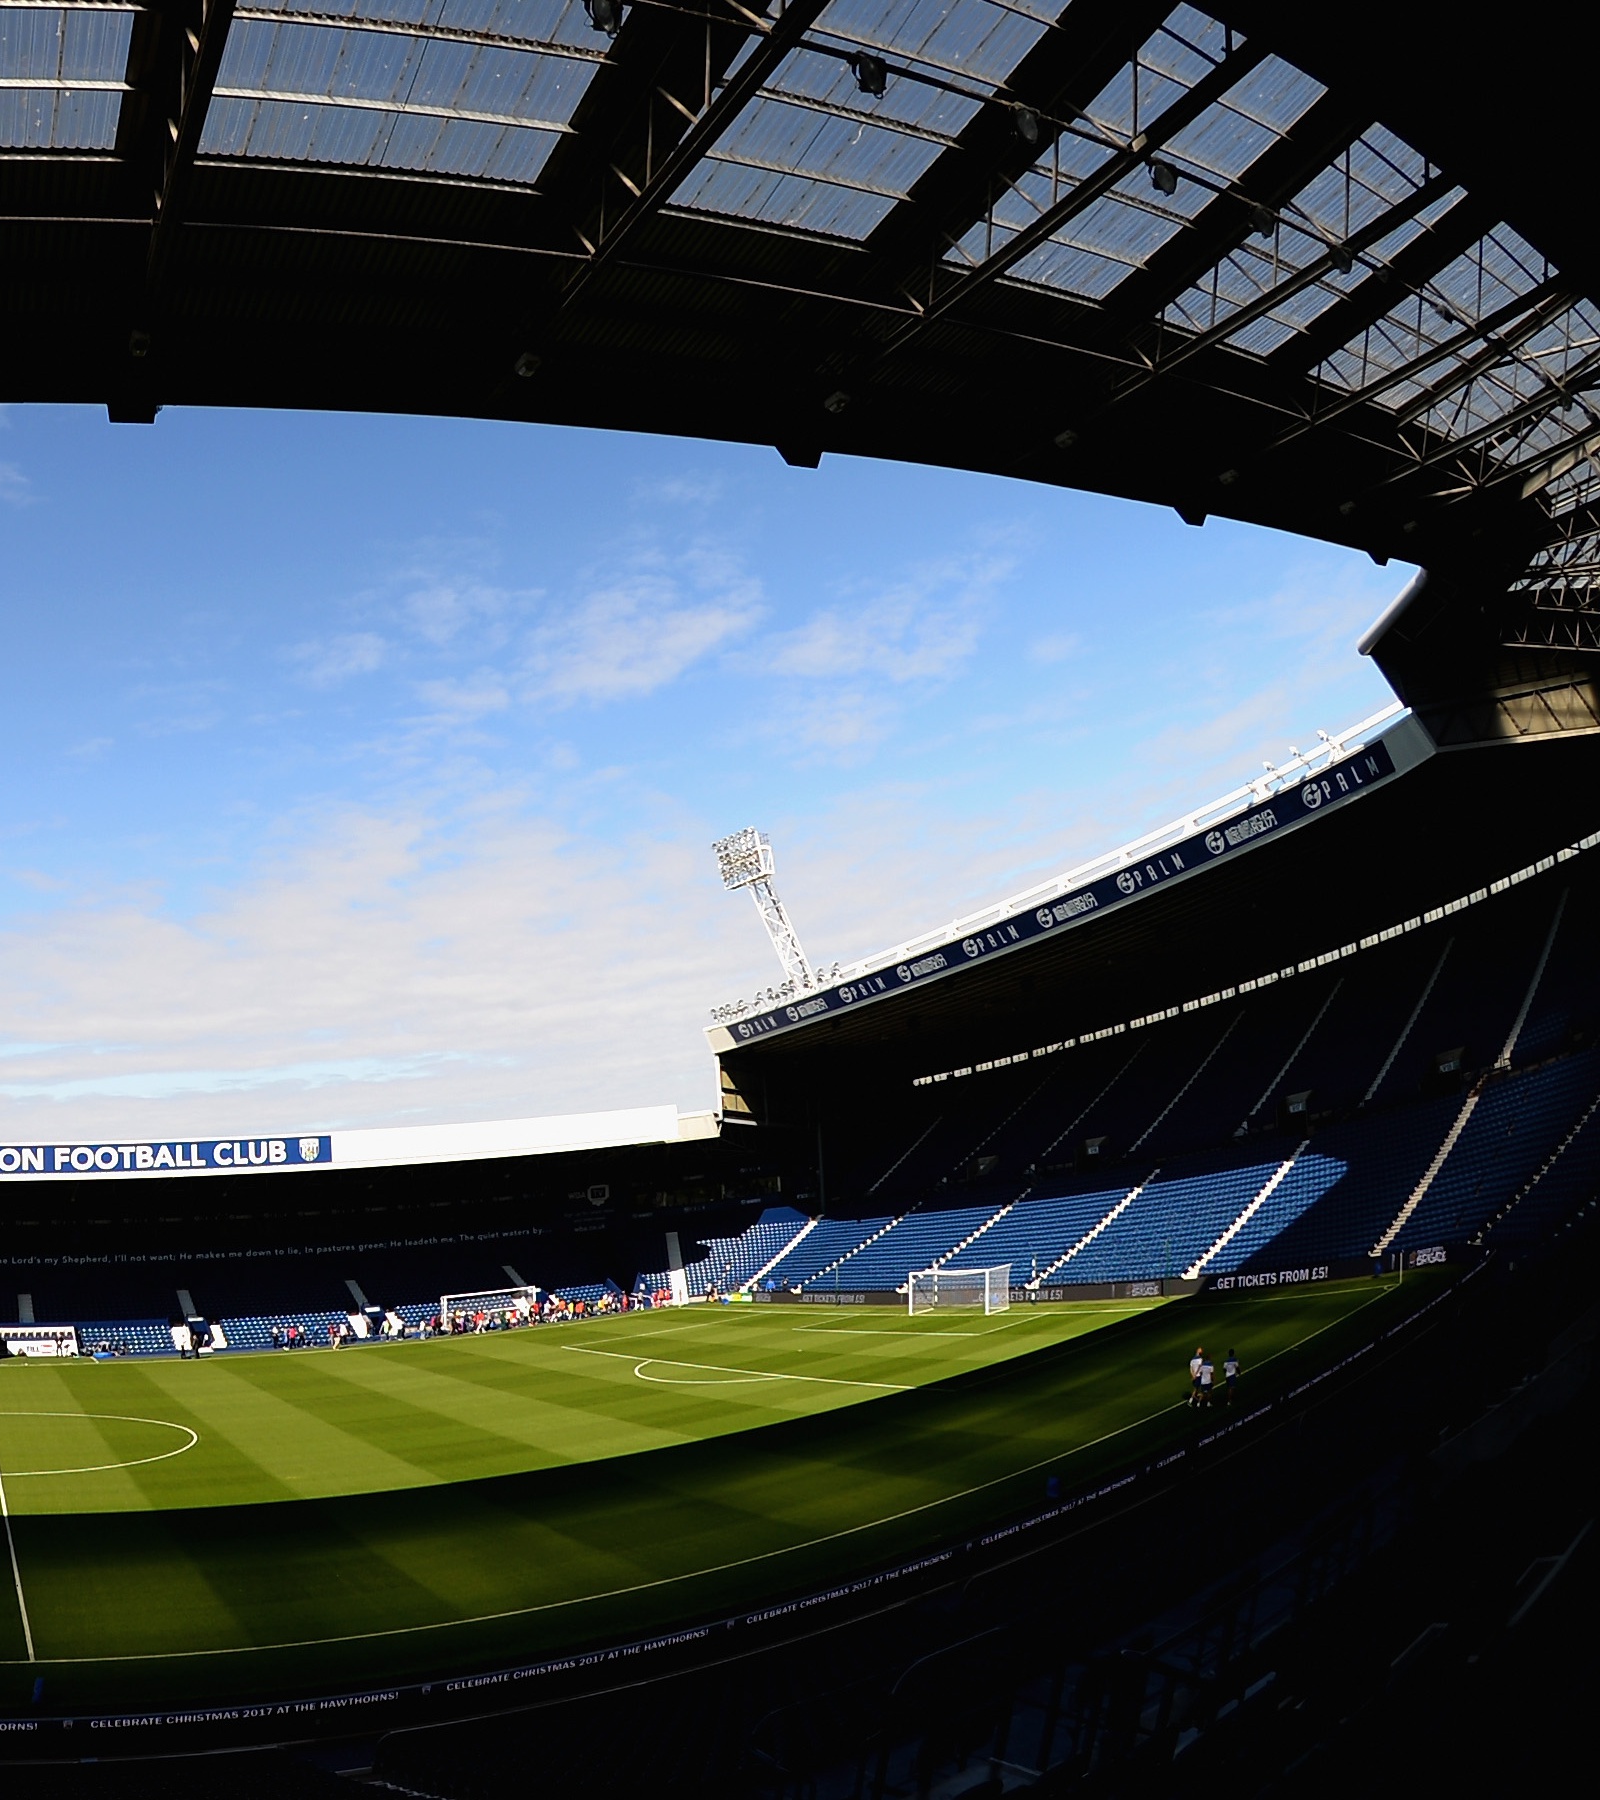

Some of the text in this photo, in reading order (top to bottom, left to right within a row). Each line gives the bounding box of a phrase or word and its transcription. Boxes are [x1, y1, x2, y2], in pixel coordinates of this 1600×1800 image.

[1320, 756, 1380, 800] PALM
[1132, 852, 1185, 887] PALM
[54, 1143, 207, 1171] FOOTBALL
[213, 1141, 287, 1166] CLUB
[11, 1256, 41, 1264] Lord's
[179, 1252, 192, 1260] He
[195, 1251, 225, 1259] makes
[245, 1249, 271, 1257] down
[274, 1248, 284, 1256] to
[405, 1237, 438, 1246] leadeth
[1237, 1272, 1277, 1288] TICKETS
[1279, 1268, 1309, 1284] FROM
[1311, 1265, 1329, 1280] £5!
[1025, 1290, 1049, 1301] FOM
[746, 1603, 798, 1625] CELEBRATE
[799, 1587, 849, 1609] CHRISTMAS
[874, 1575, 883, 1585] AT
[446, 1629, 709, 1691] CELEBRATE CHRISTMAS 2017 AT THE HAWTHORNS!
[90, 1691, 399, 1728] CELEBRATE CHRISTMAS 2017 AT THE HAWTHORNS!
